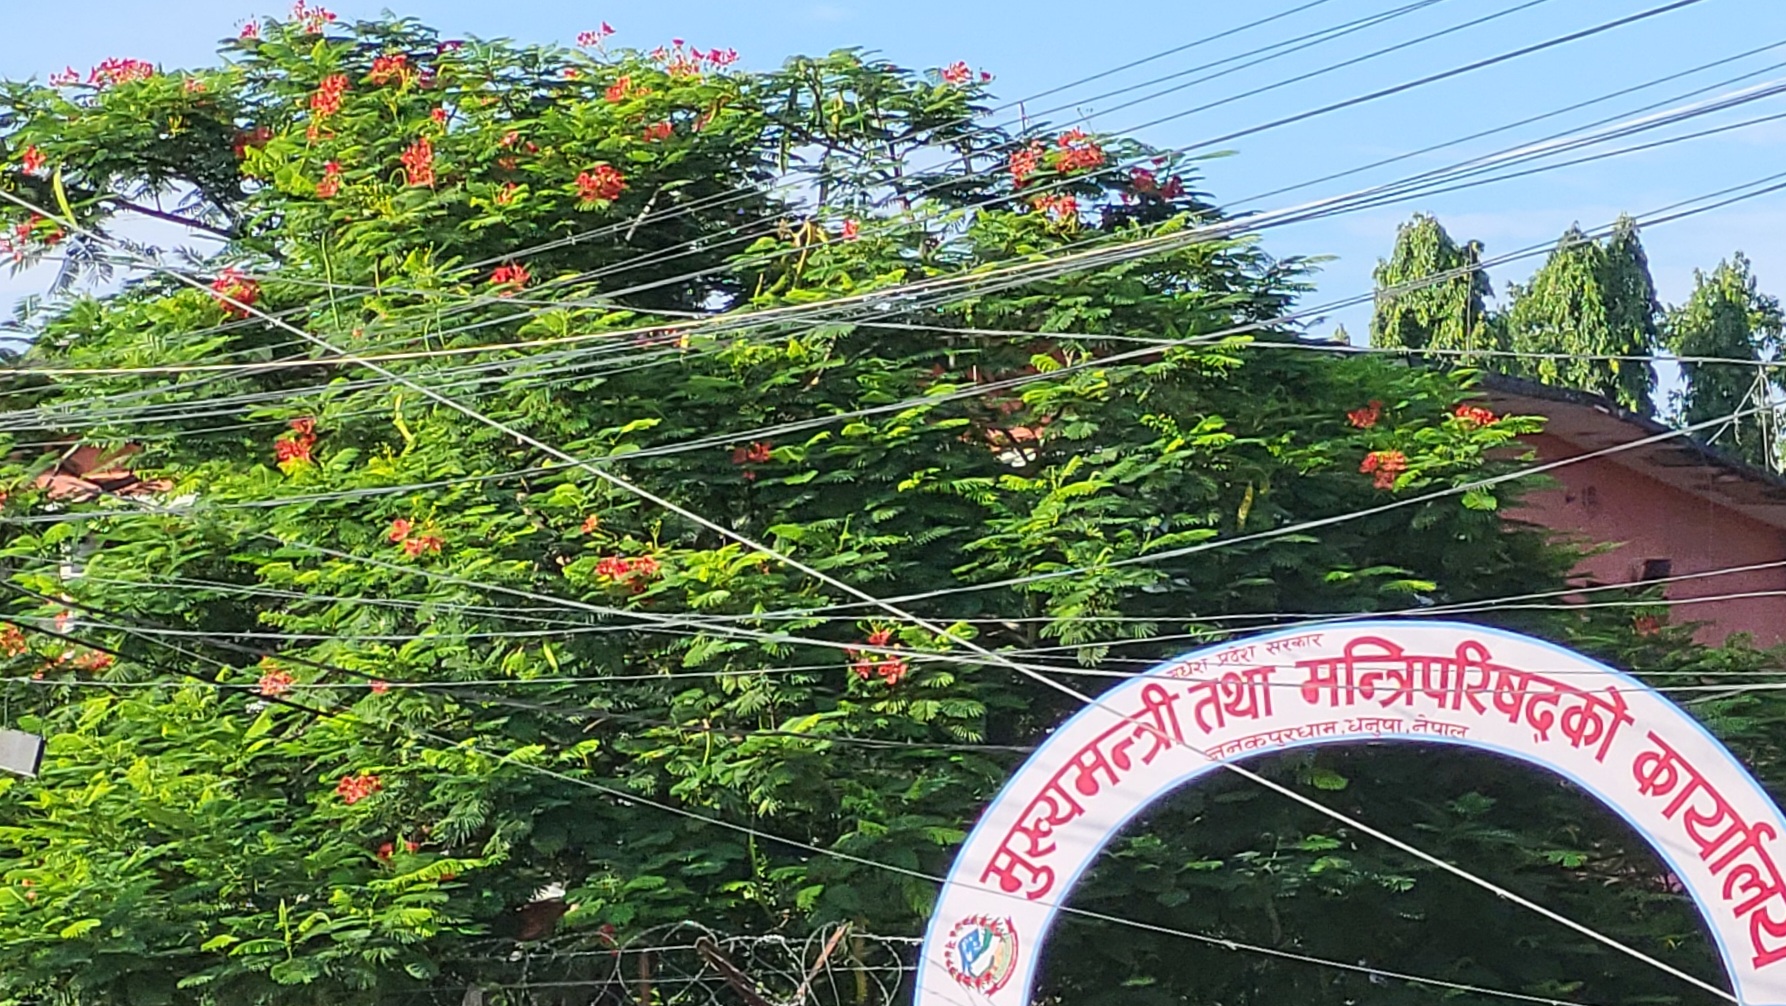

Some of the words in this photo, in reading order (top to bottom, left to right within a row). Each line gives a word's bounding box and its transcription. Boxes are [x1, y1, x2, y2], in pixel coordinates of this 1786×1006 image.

[1264, 633, 1324, 656] सरकार
[979, 682, 1184, 901] मुख्यमन्त्री
[1187, 665, 1276, 735] तथा
